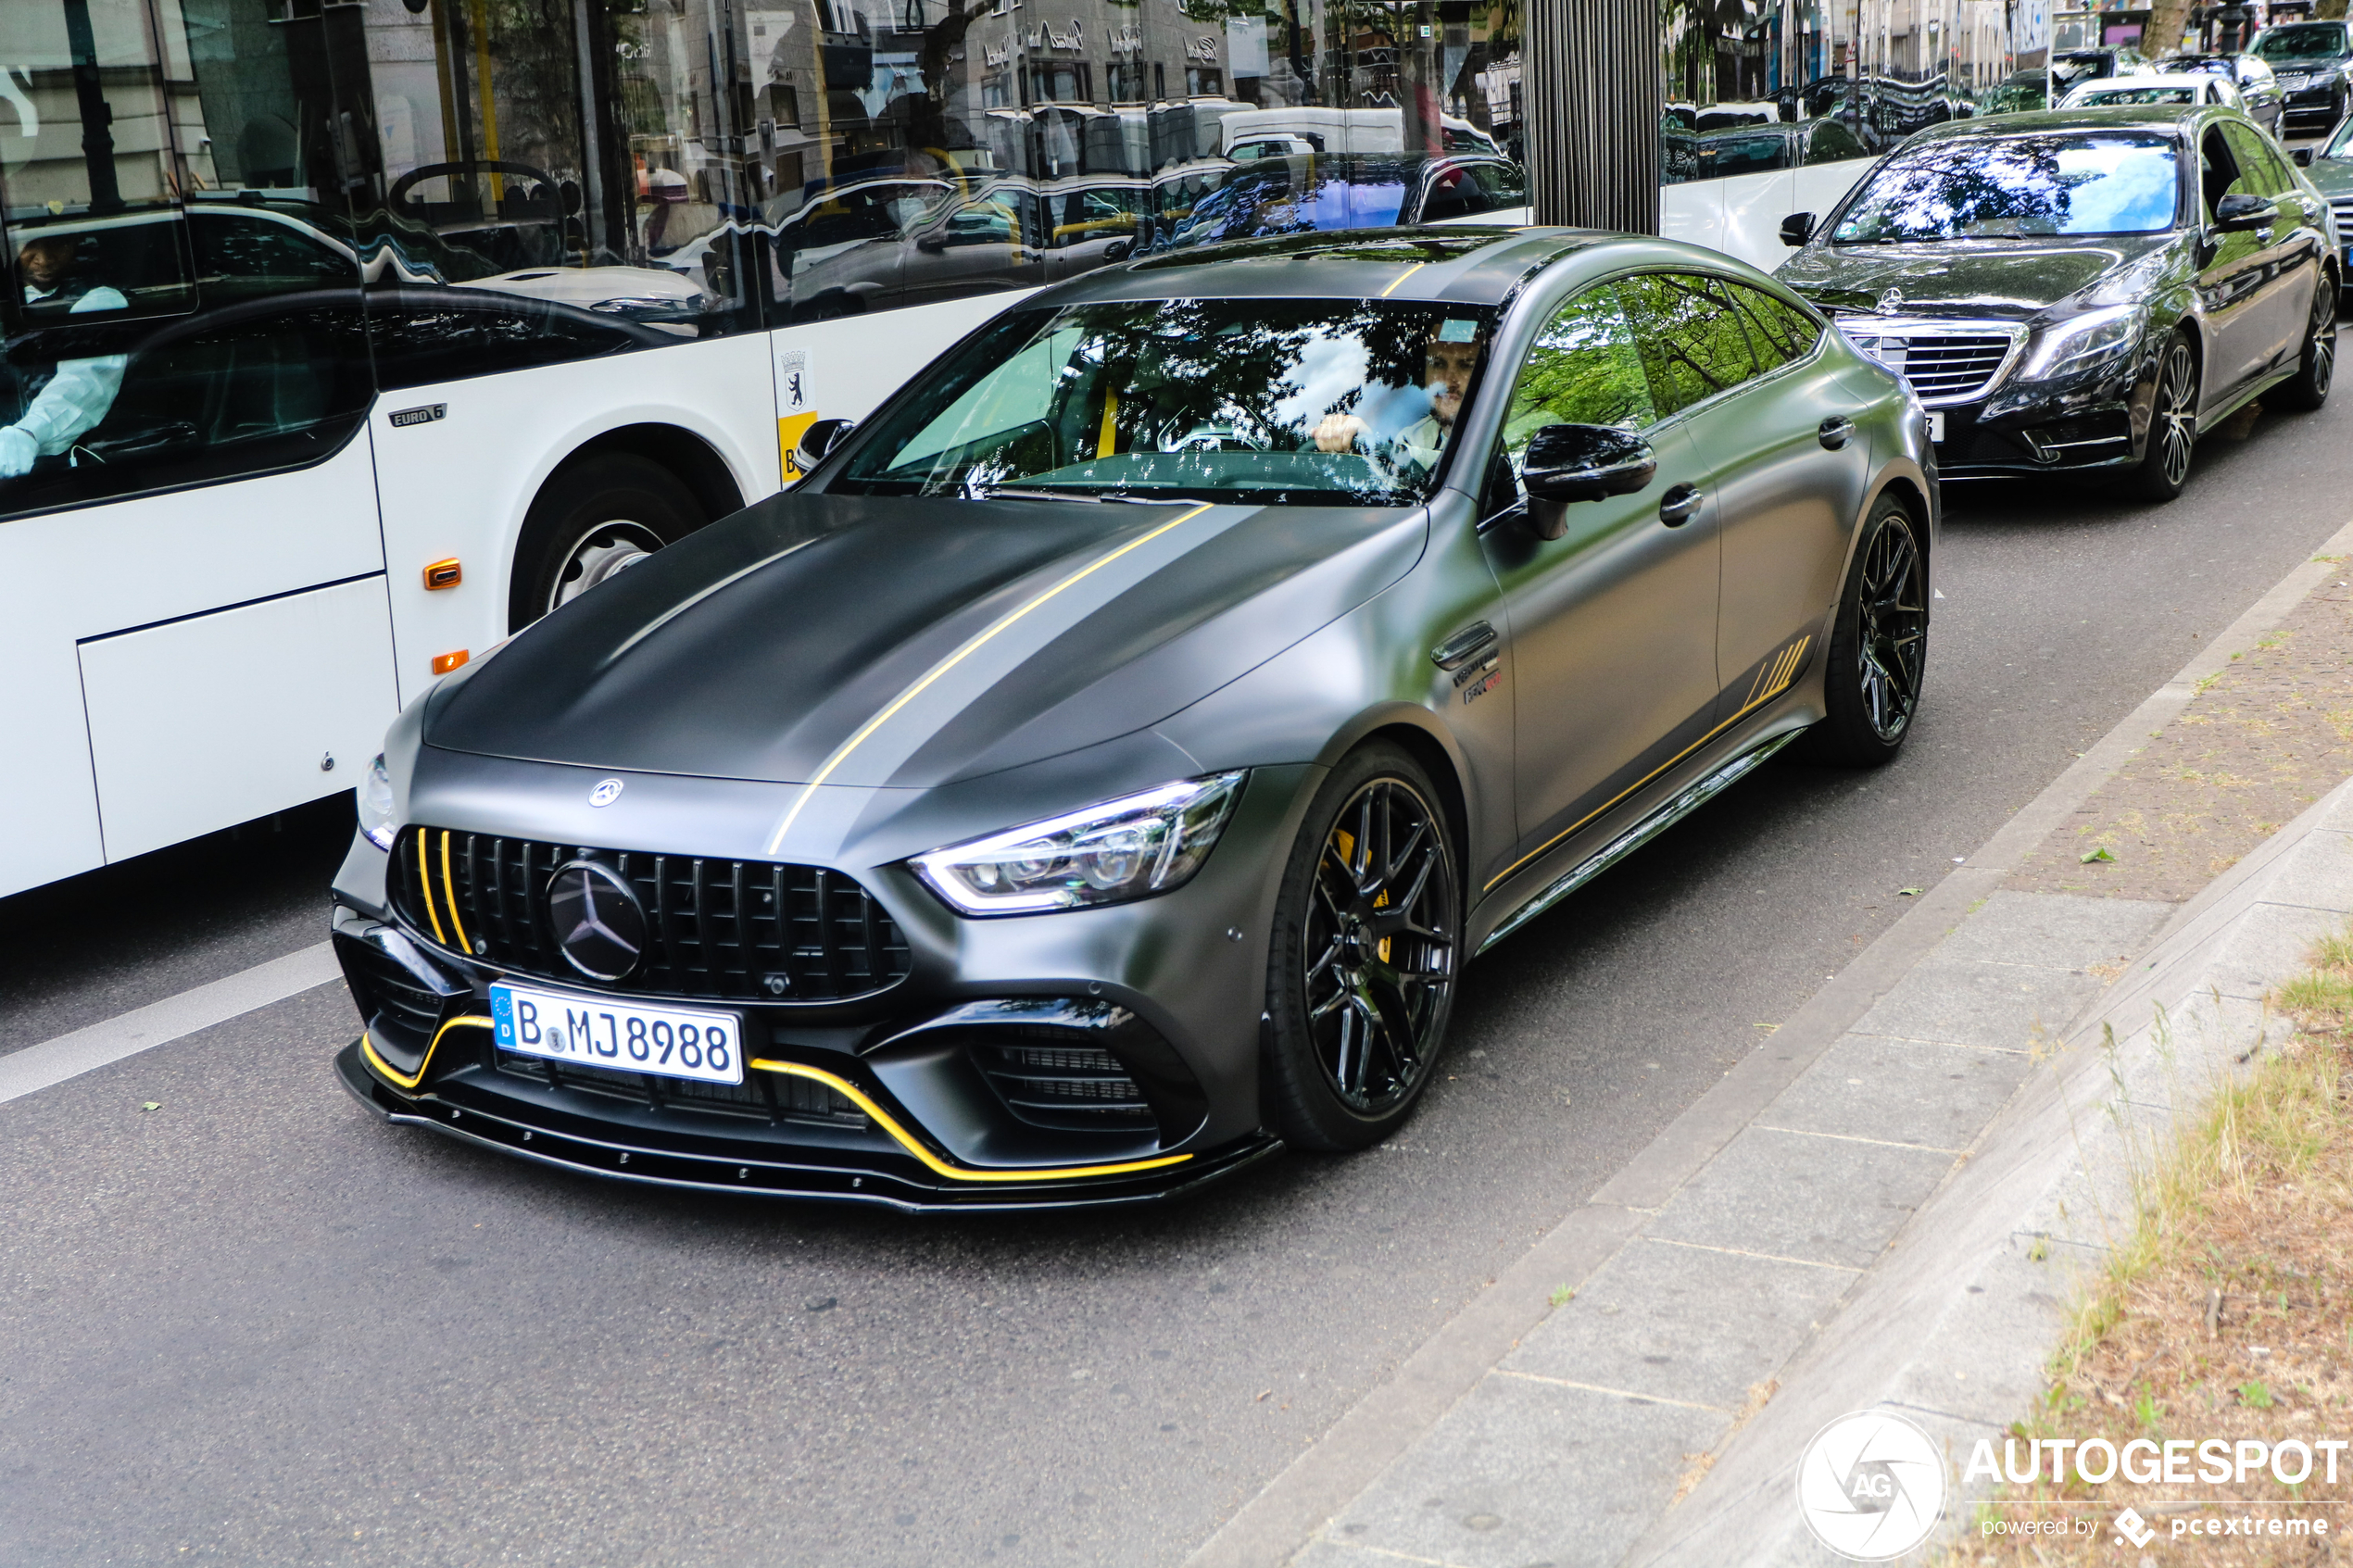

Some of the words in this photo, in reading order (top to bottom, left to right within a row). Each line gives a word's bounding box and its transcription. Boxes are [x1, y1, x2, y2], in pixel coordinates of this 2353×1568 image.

[395, 410, 428, 425] EURO
[433, 405, 444, 419] 6
[501, 1022, 510, 1038] D
[517, 999, 542, 1045] B
